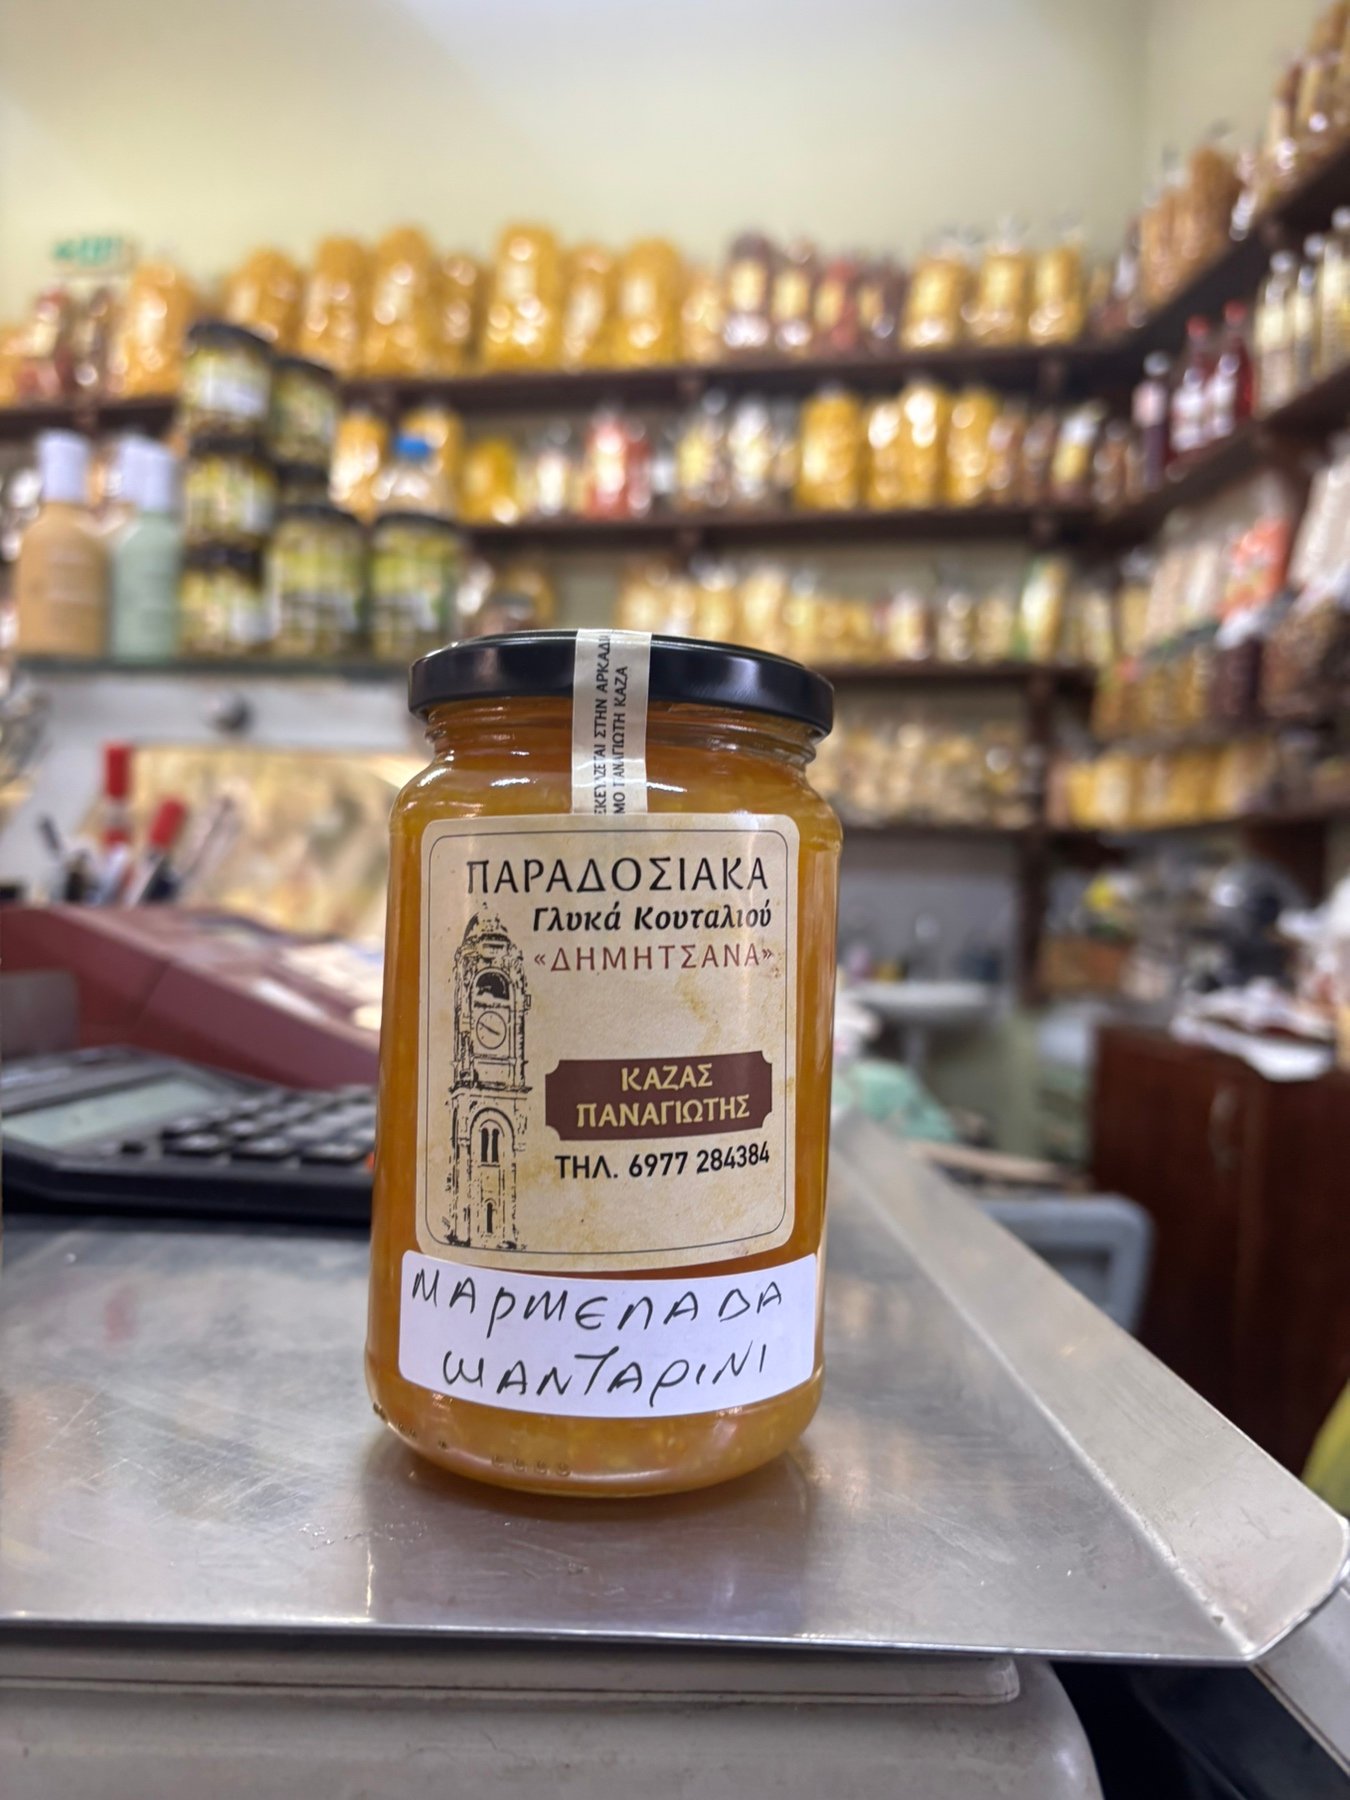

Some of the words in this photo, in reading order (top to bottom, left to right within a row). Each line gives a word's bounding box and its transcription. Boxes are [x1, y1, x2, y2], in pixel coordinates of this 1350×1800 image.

[613, 665, 629, 708] ΚΑΖΑ
[593, 698, 608, 740] ΣΤΗΝ
[467, 856, 769, 895] ΠΑΡΑΔΟΣΙΑΚΑ
[533, 901, 622, 932] Γλυκά
[634, 899, 772, 931] Κουταλιού
[534, 943, 773, 972] «ΔΗΜΗΤΣΑΝΑ»
[621, 1063, 713, 1092] ΚΑΖΑΣ
[576, 1094, 750, 1128] ΠΑΝΑΓΙΩΤΗΣ
[554, 1154, 619, 1180] ΤΗΛ.
[628, 1150, 689, 1178] 6977
[696, 1140, 771, 1174] 284384
